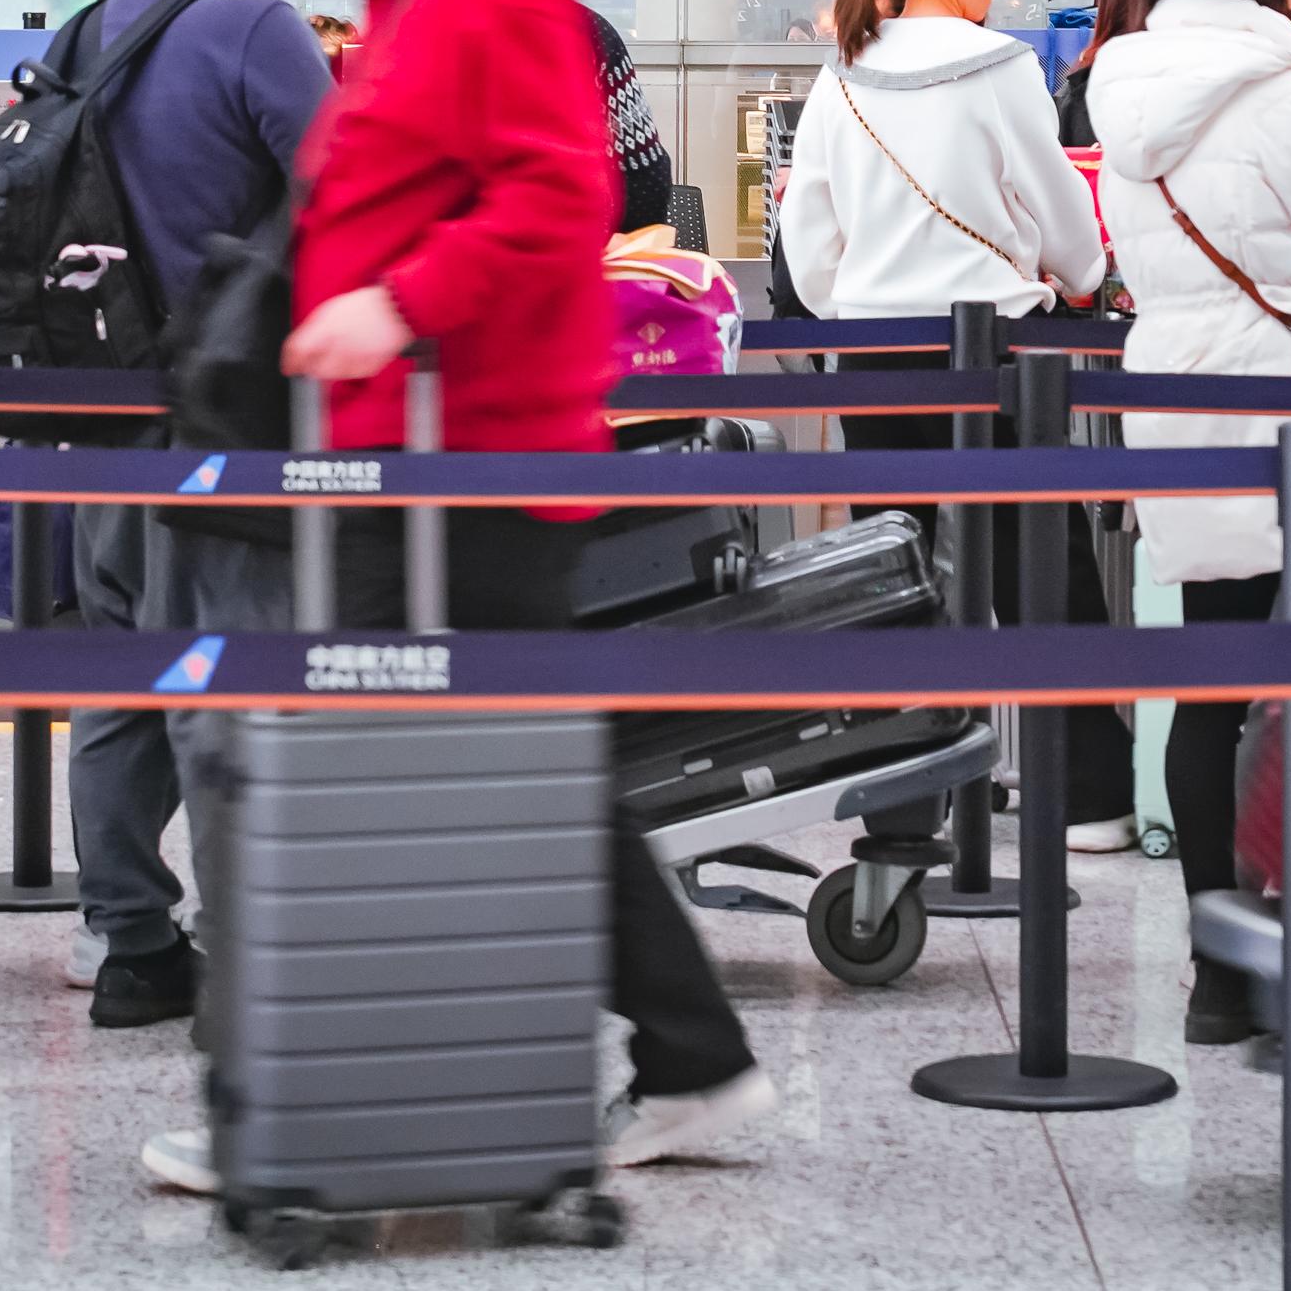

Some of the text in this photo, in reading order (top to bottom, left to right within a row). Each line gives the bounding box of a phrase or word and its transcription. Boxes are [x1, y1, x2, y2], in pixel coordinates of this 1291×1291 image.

[281, 476, 381, 492] CHINA SOUTHERN
[305, 667, 450, 691] CHINA SOUTHERN
